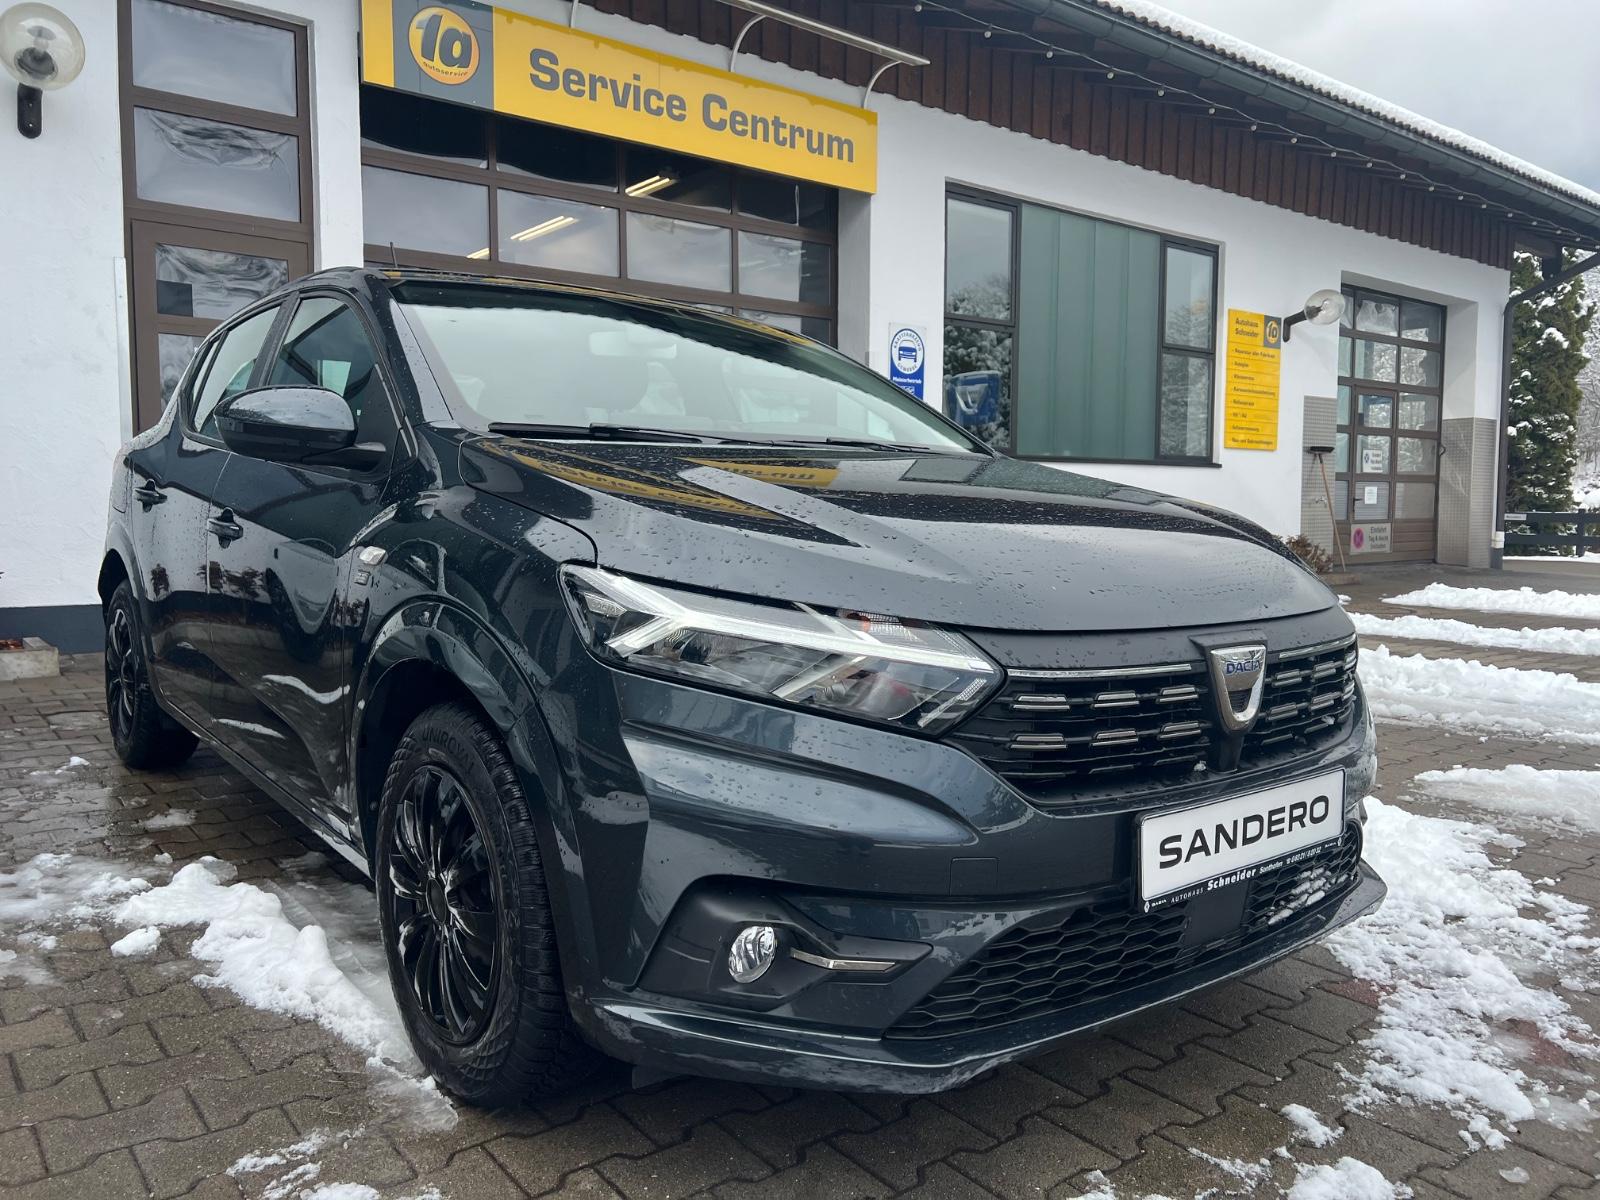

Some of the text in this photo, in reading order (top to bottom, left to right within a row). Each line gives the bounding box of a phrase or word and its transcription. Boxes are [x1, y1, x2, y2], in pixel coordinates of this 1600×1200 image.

[529, 47, 855, 164] Service Centrum
[1226, 659, 1261, 675] DACIA
[1159, 795, 1330, 870] SANDERO
[1170, 887, 1204, 904] AUTOHAUS
[1207, 867, 1257, 891] Schneider
